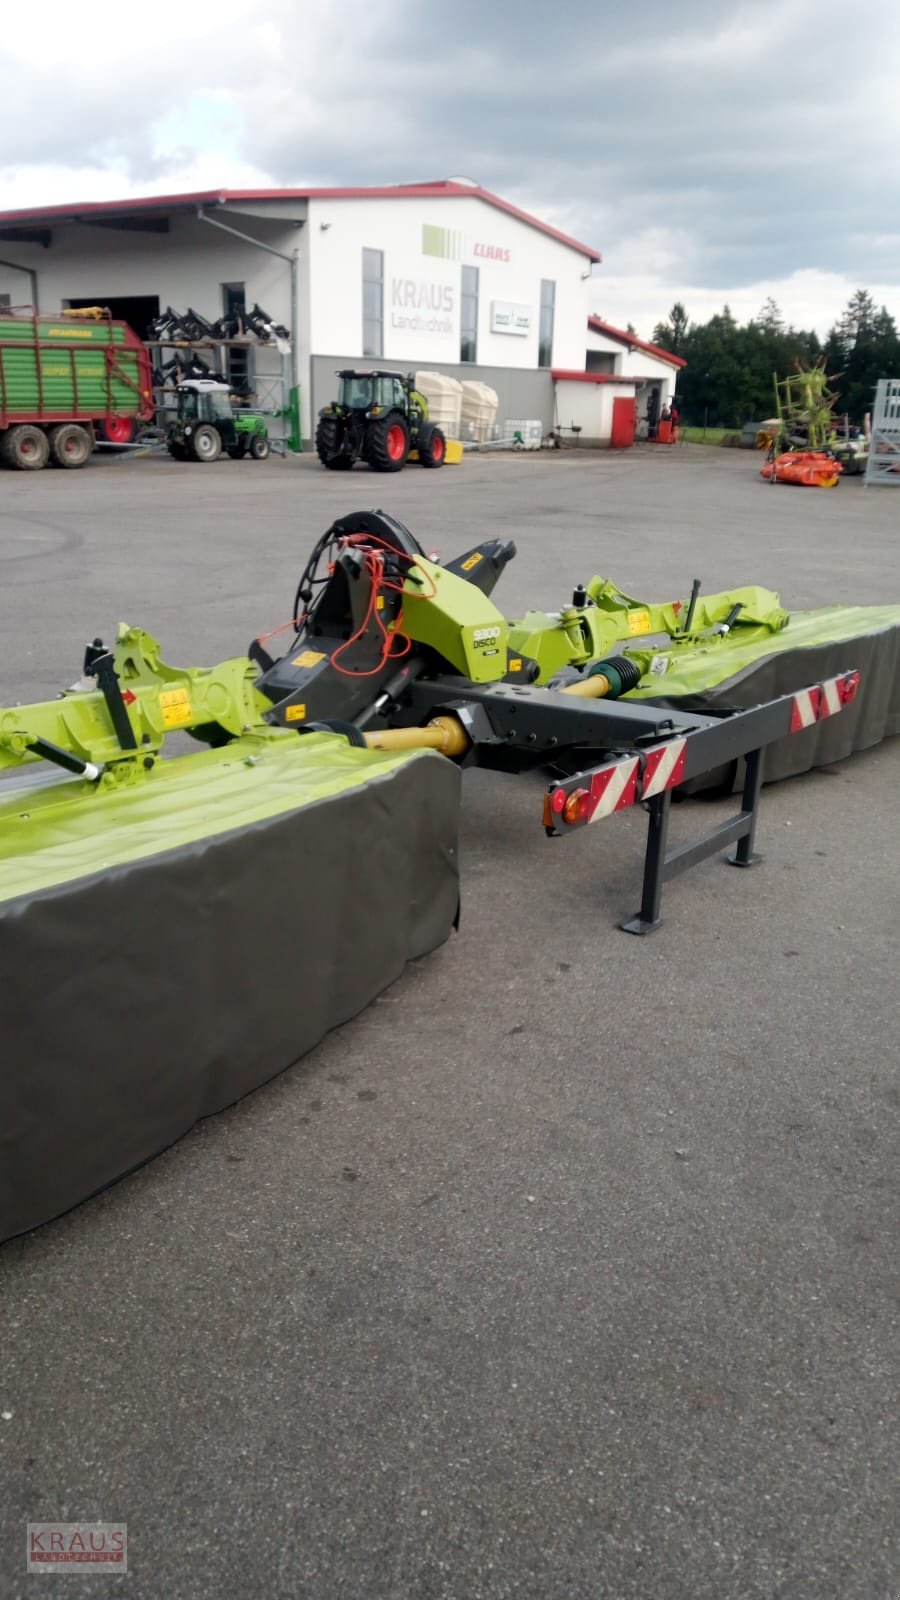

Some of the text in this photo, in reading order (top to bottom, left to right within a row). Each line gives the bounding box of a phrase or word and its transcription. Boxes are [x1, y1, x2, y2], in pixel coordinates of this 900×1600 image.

[473, 242, 511, 262] CLAAS
[391, 277, 454, 313] KRAUS
[473, 637, 496, 648] DISCO
